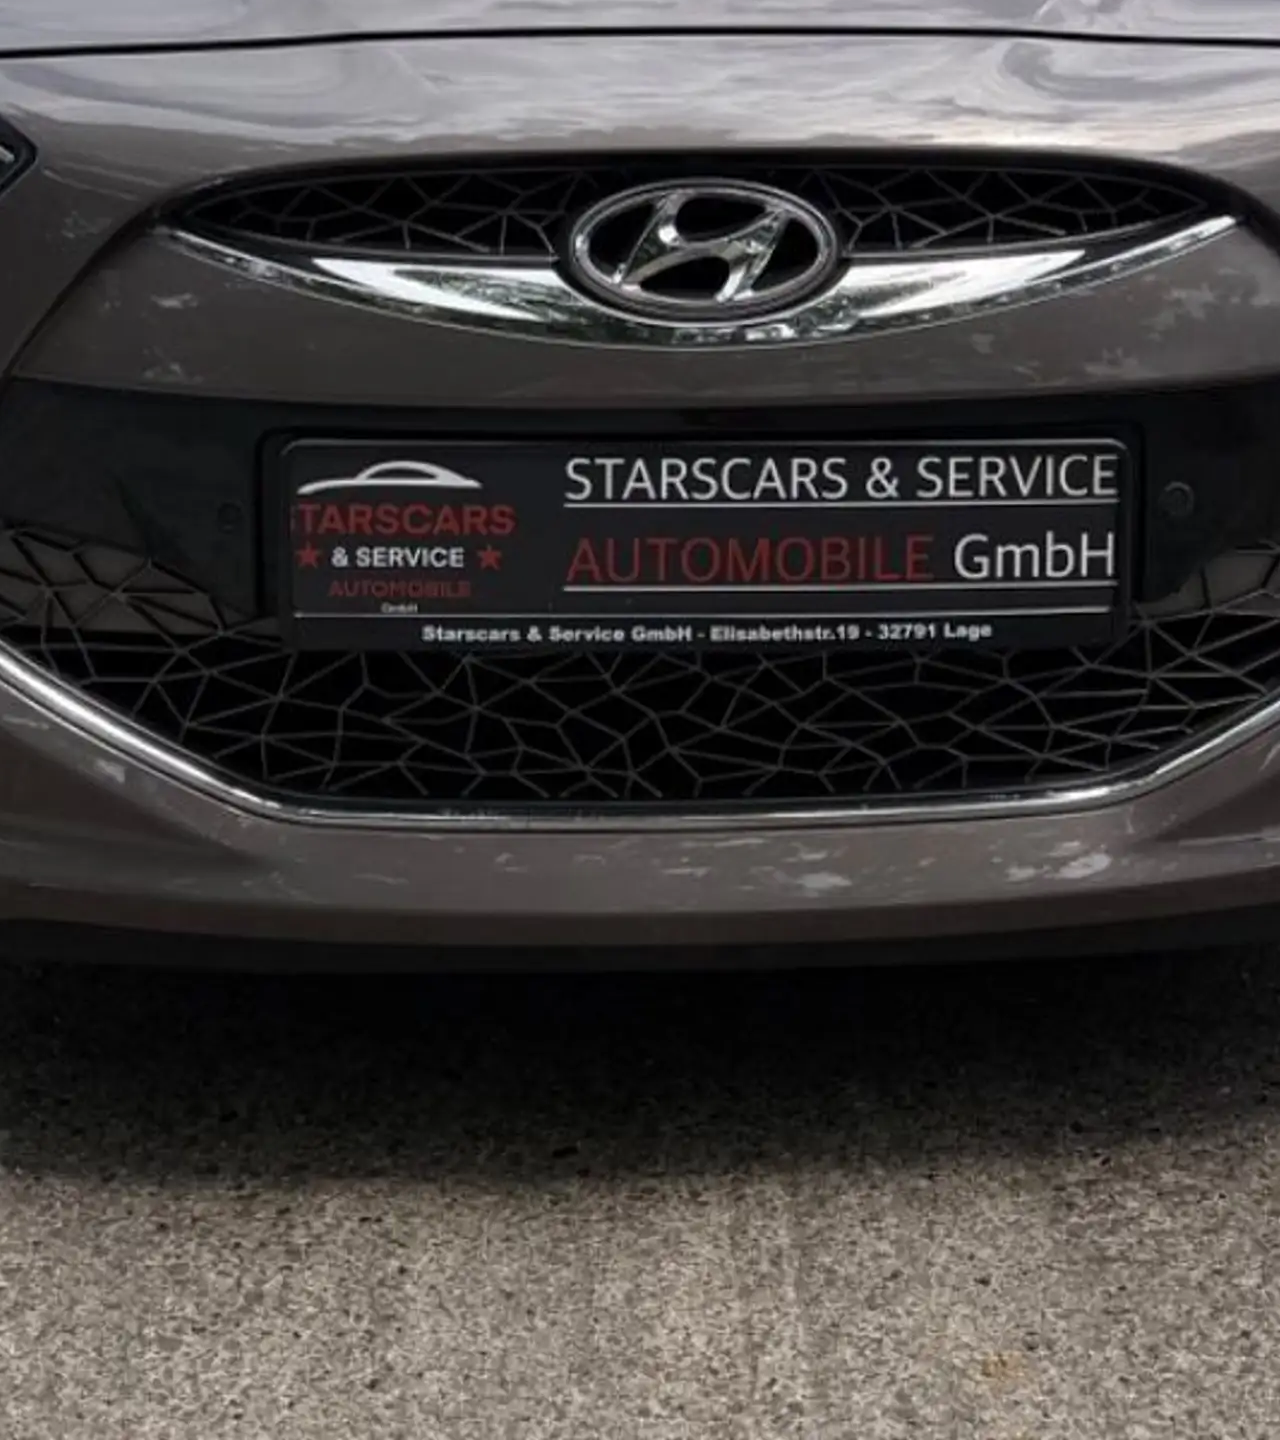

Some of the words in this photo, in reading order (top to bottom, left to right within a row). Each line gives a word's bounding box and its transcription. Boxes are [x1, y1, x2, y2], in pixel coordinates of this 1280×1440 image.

[565, 456, 848, 501] STARSCARS
[865, 456, 901, 499] &
[916, 454, 1118, 498] SERVICE
[291, 501, 516, 536] TARSCARS
[331, 546, 349, 568] &
[355, 546, 465, 568] SERVICE
[566, 534, 934, 583] AUTOMOBILE
[953, 529, 1115, 580] GmbH
[329, 578, 472, 598] AUTOMOBILE
[421, 624, 520, 643] Starscars
[526, 624, 543, 642] &
[548, 624, 625, 642] Service
[630, 624, 693, 642] GmbH
[877, 623, 936, 641] 32791
[942, 621, 993, 641] Lage
